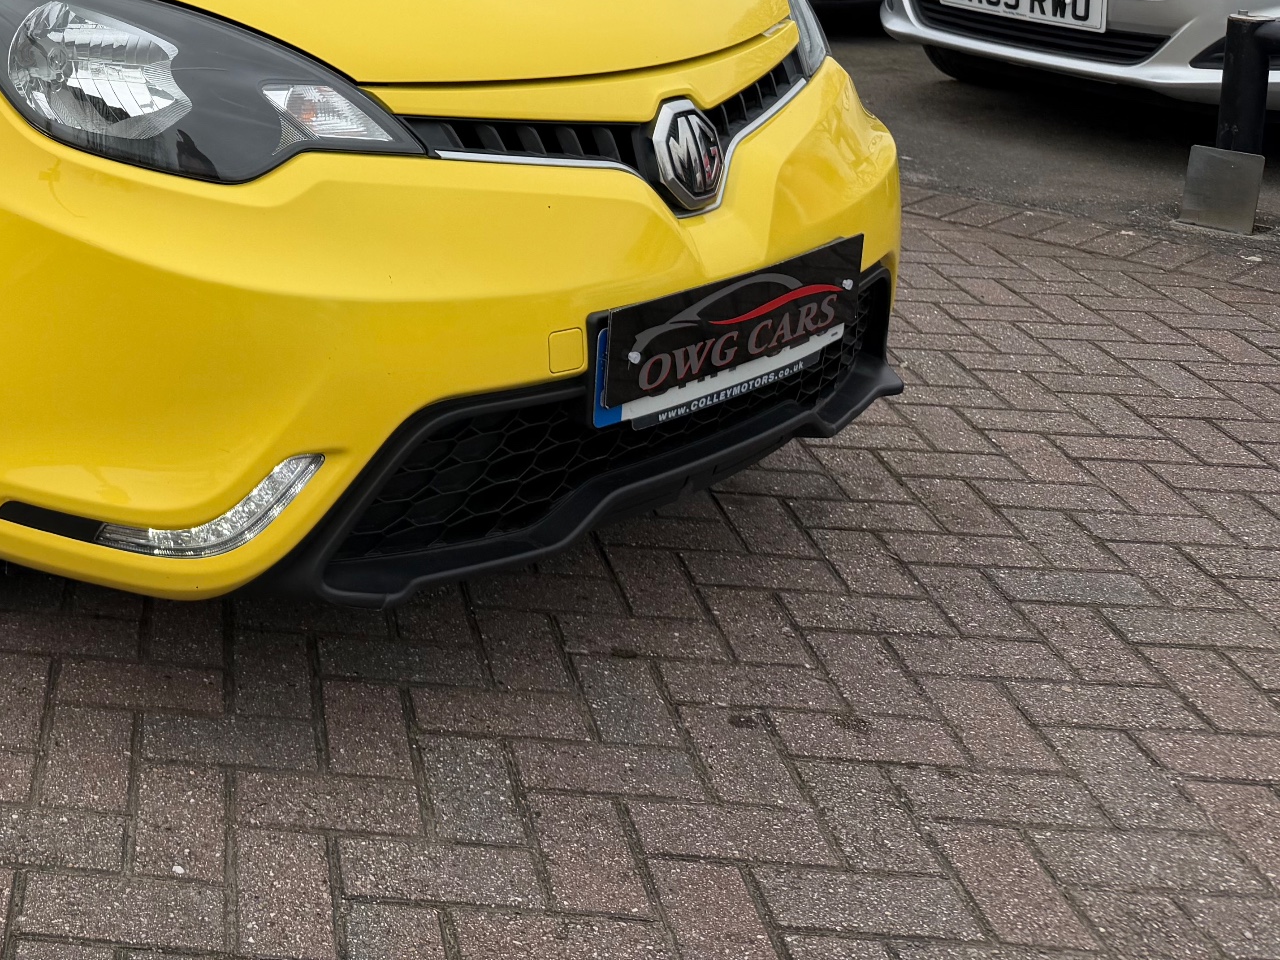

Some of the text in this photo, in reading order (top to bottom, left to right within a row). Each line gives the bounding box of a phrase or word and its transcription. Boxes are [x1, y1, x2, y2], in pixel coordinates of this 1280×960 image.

[668, 114, 721, 193] MG
[639, 294, 838, 391] OWG CARS
[658, 360, 804, 422] www.COLLEYMOTORS.co.uk
